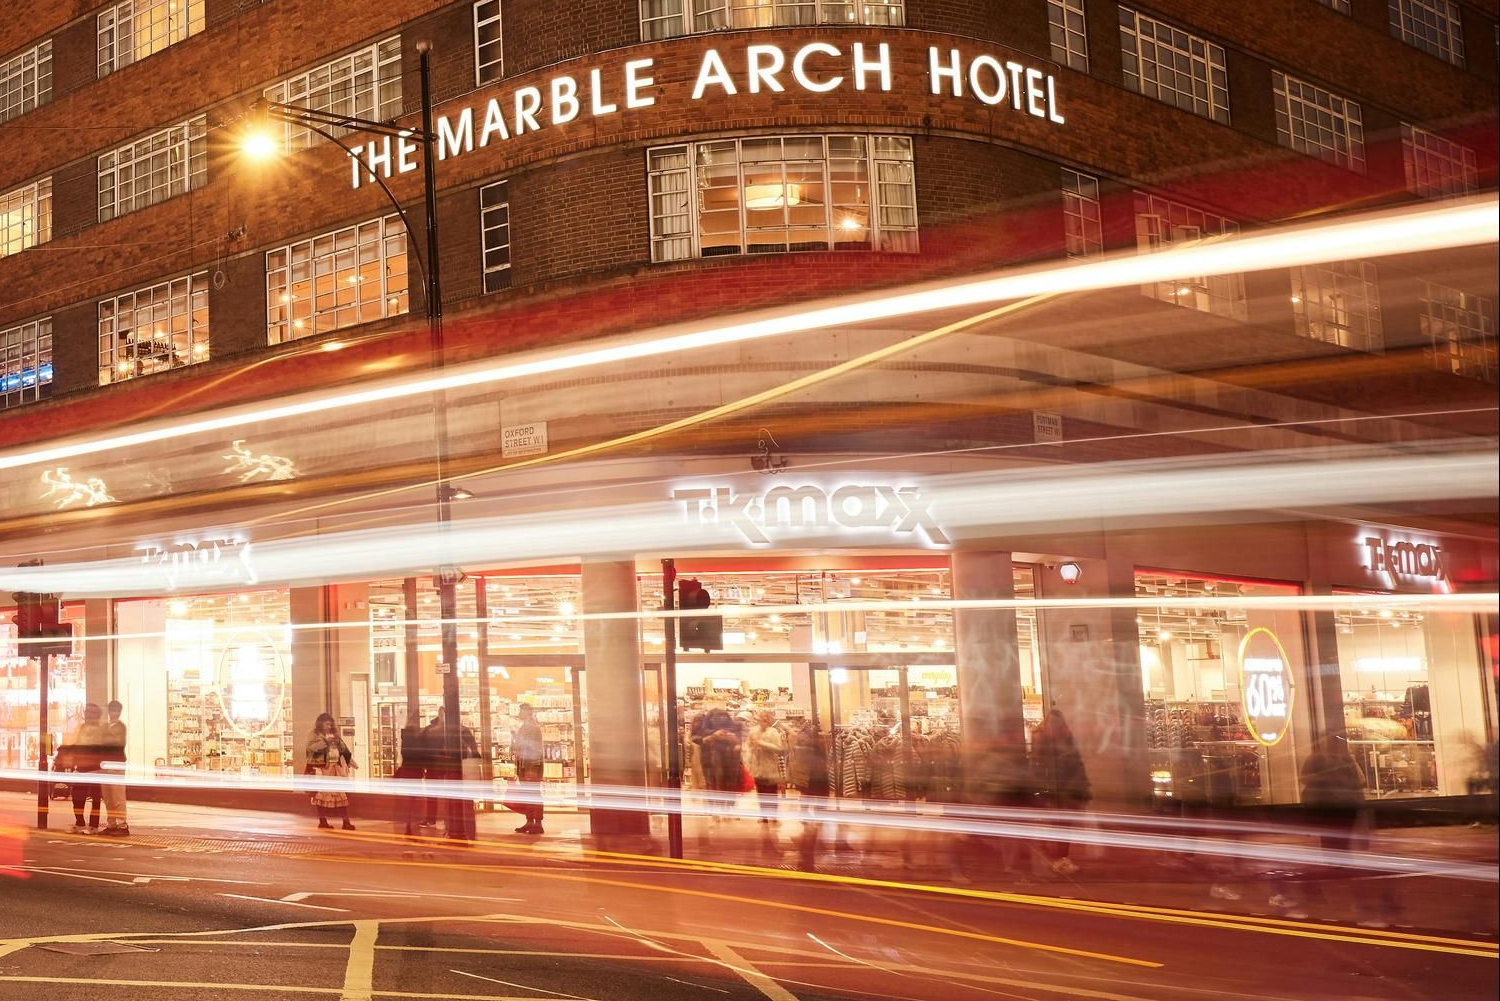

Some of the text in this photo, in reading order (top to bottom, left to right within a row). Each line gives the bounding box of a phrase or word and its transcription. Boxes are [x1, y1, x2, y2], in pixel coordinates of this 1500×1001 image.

[347, 42, 1065, 189] THE MARBLE ARCH HOTEL
[505, 427, 534, 438] OXFORD
[505, 436, 531, 448] STREET
